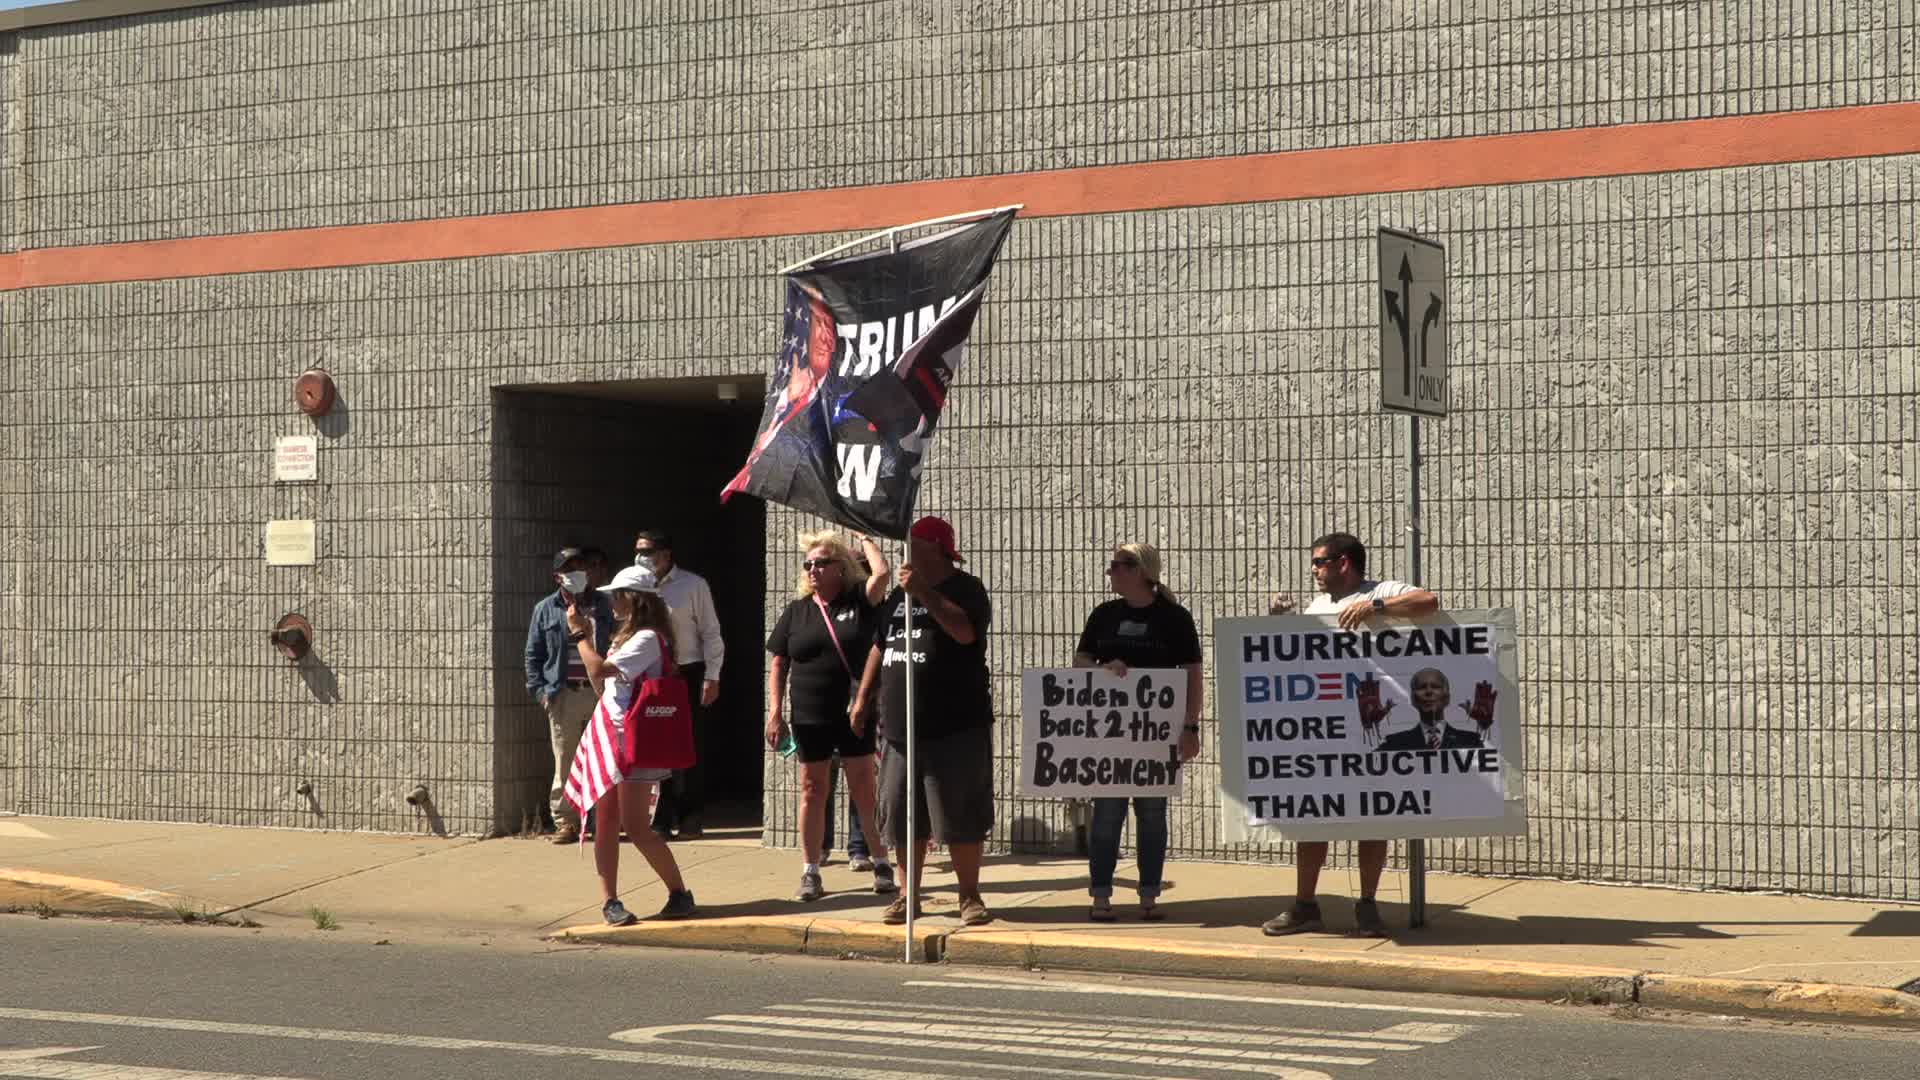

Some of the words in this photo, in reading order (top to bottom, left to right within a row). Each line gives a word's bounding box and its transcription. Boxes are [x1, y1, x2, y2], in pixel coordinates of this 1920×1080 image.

[1419, 374, 1444, 402] ONLY
[893, 602, 928, 616] BDEN
[1243, 627, 1489, 662] HURRICANE
[1042, 672, 1128, 707] Biden
[1136, 675, 1175, 709] Go
[1040, 709, 1099, 738] Back
[1104, 710, 1125, 738] 2
[1128, 711, 1170, 741] the
[1247, 716, 1346, 742] MORE
[1033, 742, 1181, 787] Basement
[1248, 749, 1499, 779] DESTRUCTIVE
[1248, 793, 1345, 819] THAN
[1360, 790, 1432, 816] IDA!
